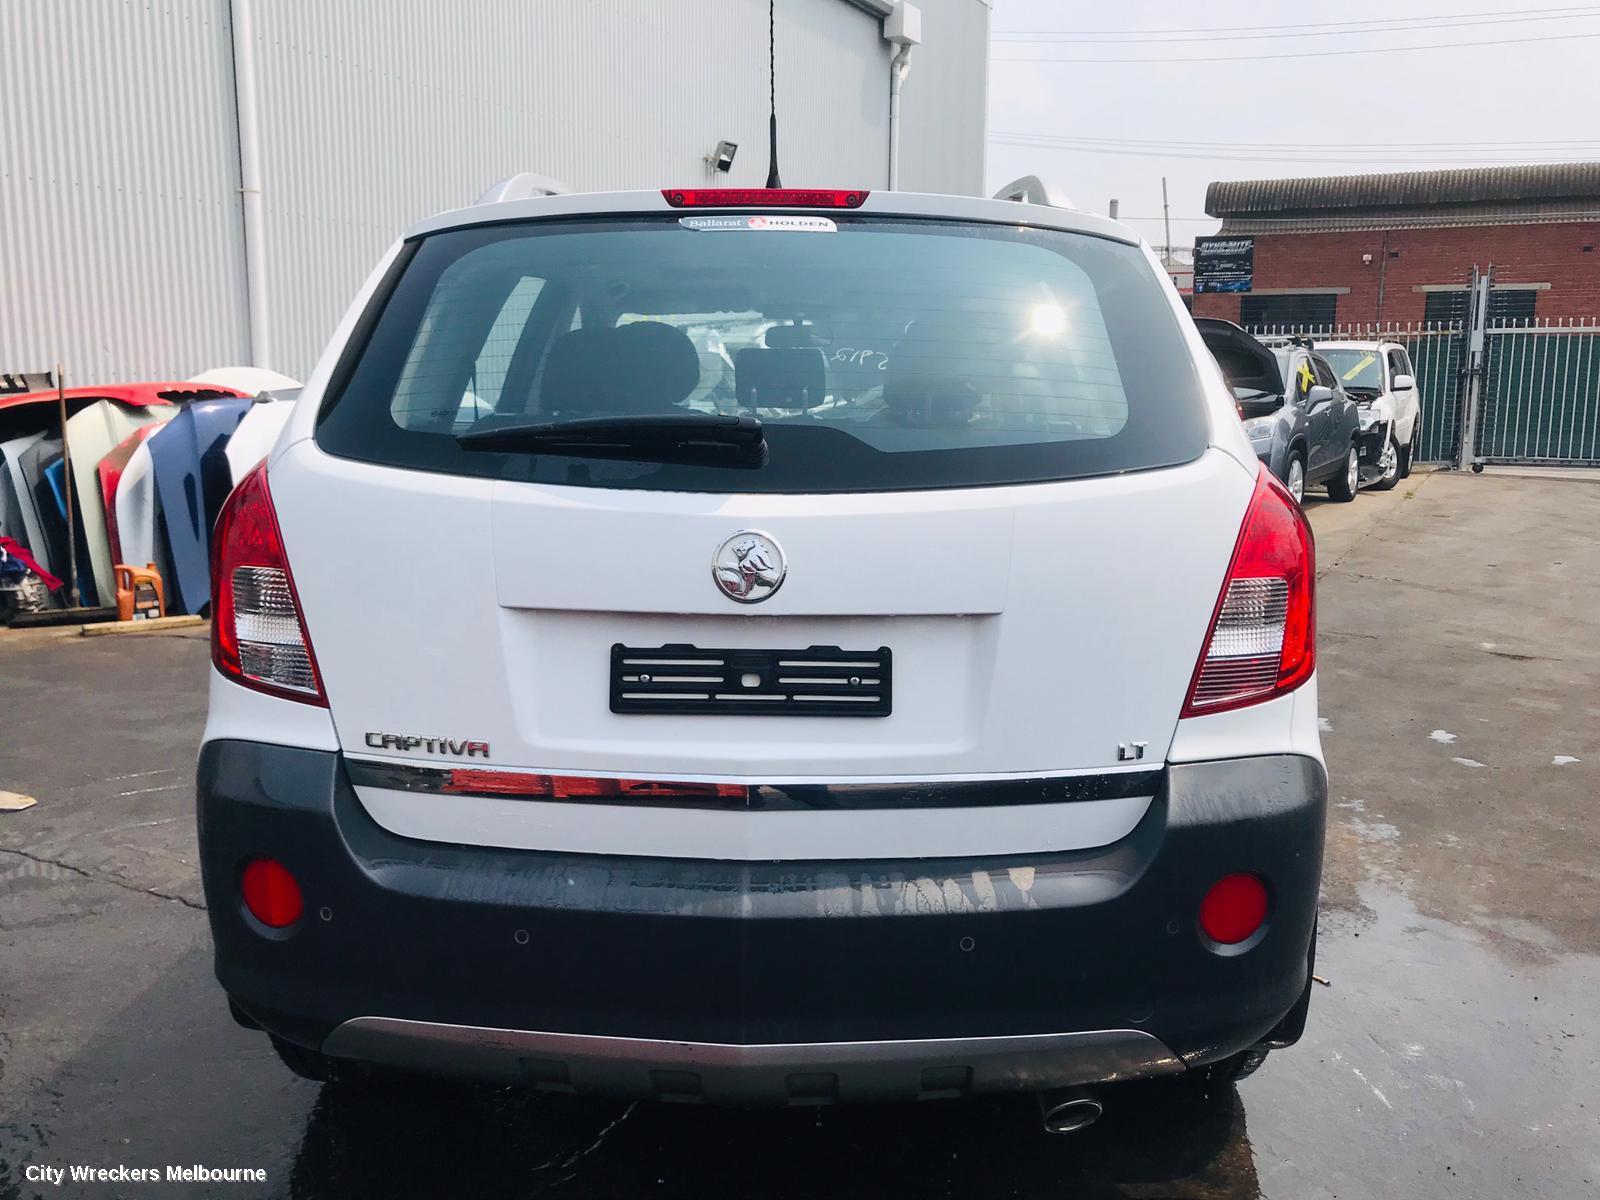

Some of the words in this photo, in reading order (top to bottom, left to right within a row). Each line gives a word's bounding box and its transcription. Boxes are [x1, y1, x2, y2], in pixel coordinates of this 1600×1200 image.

[690, 219, 741, 229] Ballarat
[365, 732, 490, 758] CAPTIVA
[1118, 741, 1149, 761] LT
